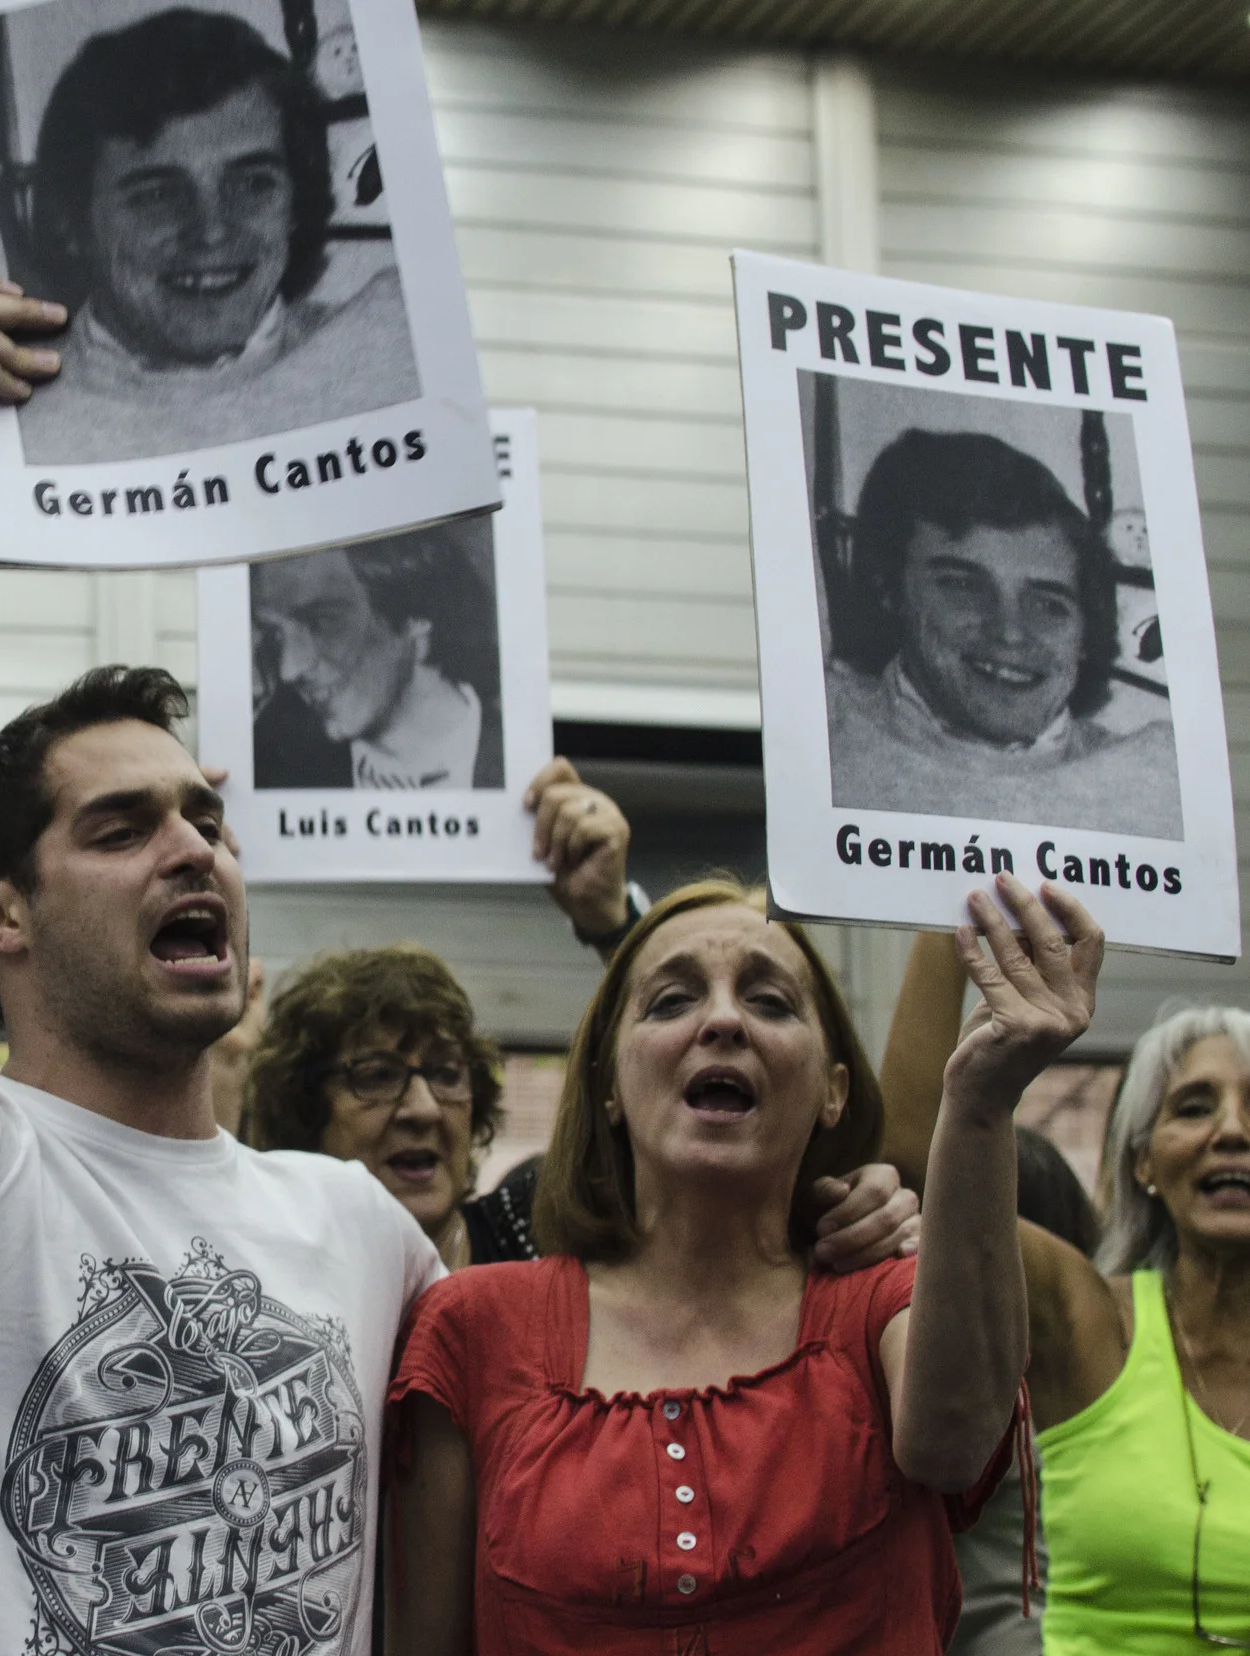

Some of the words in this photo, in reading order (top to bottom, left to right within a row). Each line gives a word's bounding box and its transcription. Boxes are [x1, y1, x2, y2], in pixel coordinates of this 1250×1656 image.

[768, 293, 1147, 401] PRESENTE
[33, 468, 230, 517] Germán
[254, 428, 428, 494] Cantos
[278, 808, 348, 838] Luis
[365, 808, 480, 838] Cantos
[836, 823, 1014, 876] Germán
[1035, 840, 1183, 895] Cantos
[47, 1362, 320, 1534] FRENTE
